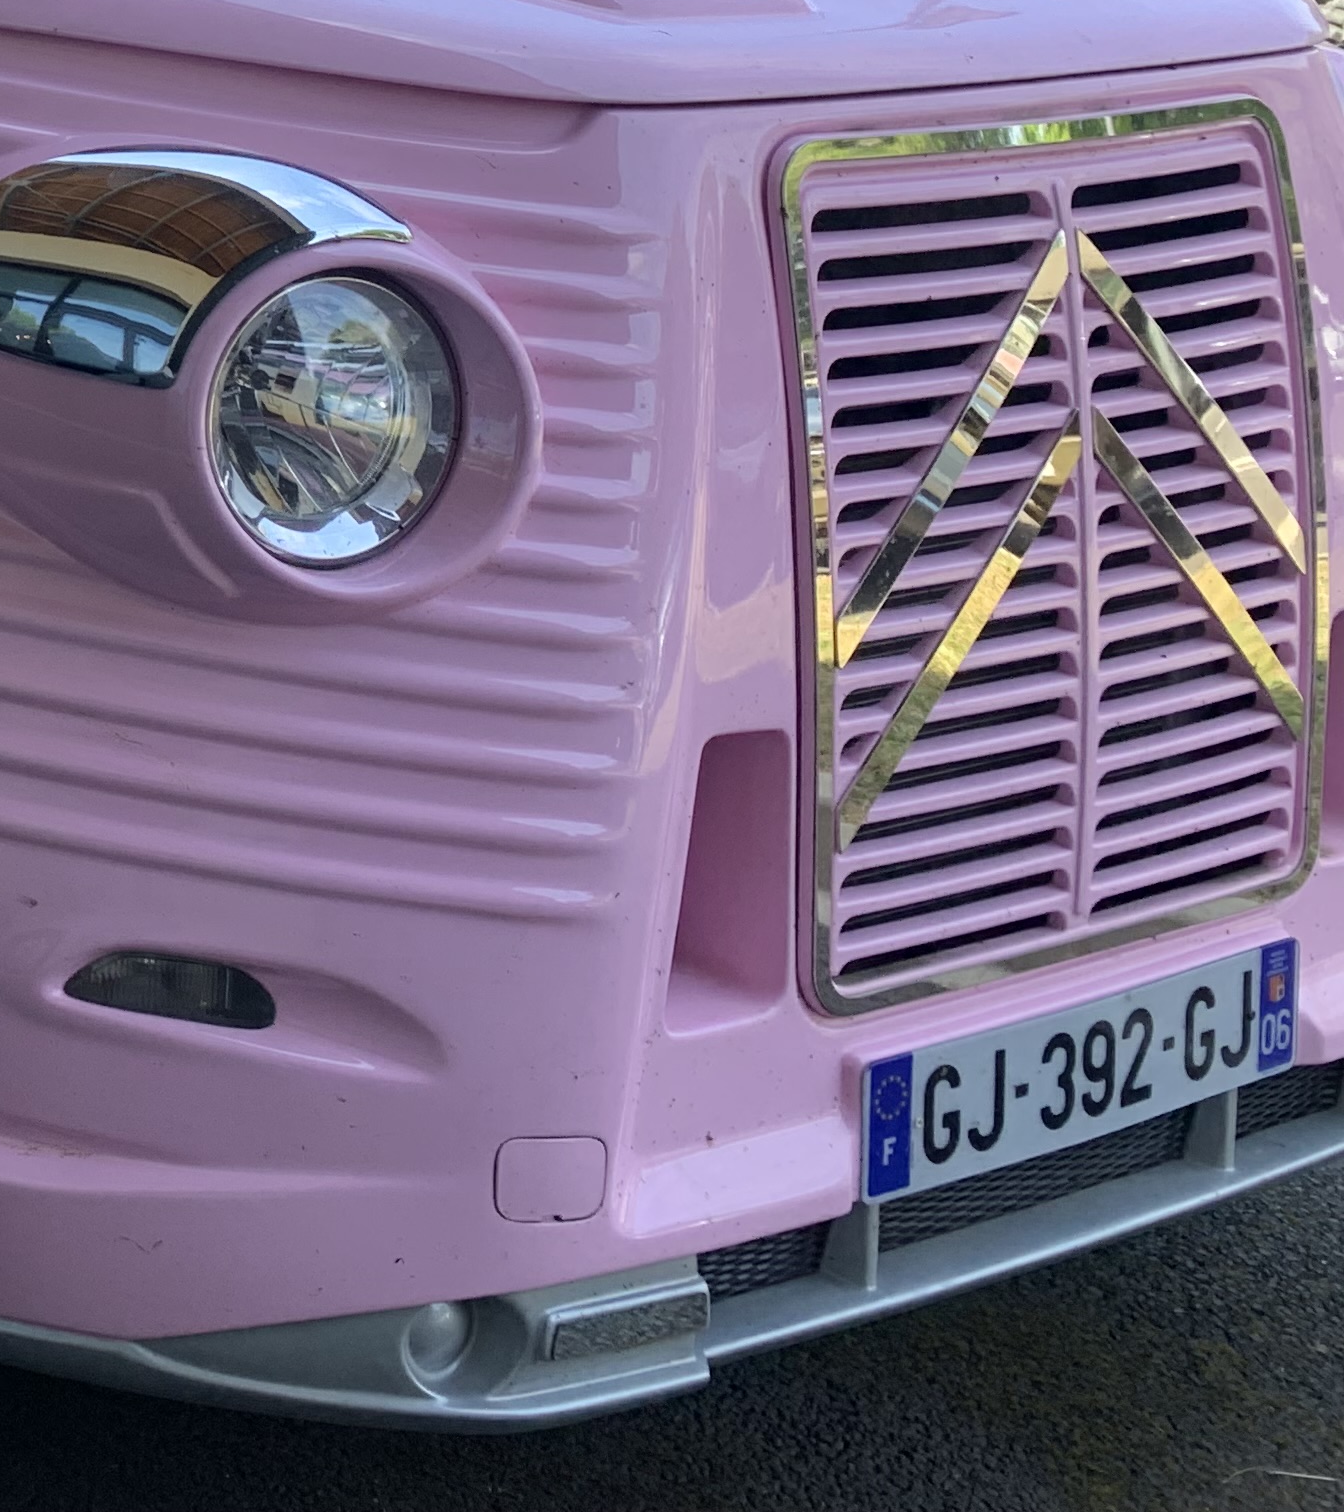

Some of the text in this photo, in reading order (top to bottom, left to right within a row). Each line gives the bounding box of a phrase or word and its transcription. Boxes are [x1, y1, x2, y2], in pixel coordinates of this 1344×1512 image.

[881, 969, 1292, 1167] F GJ-392-GJ 06
